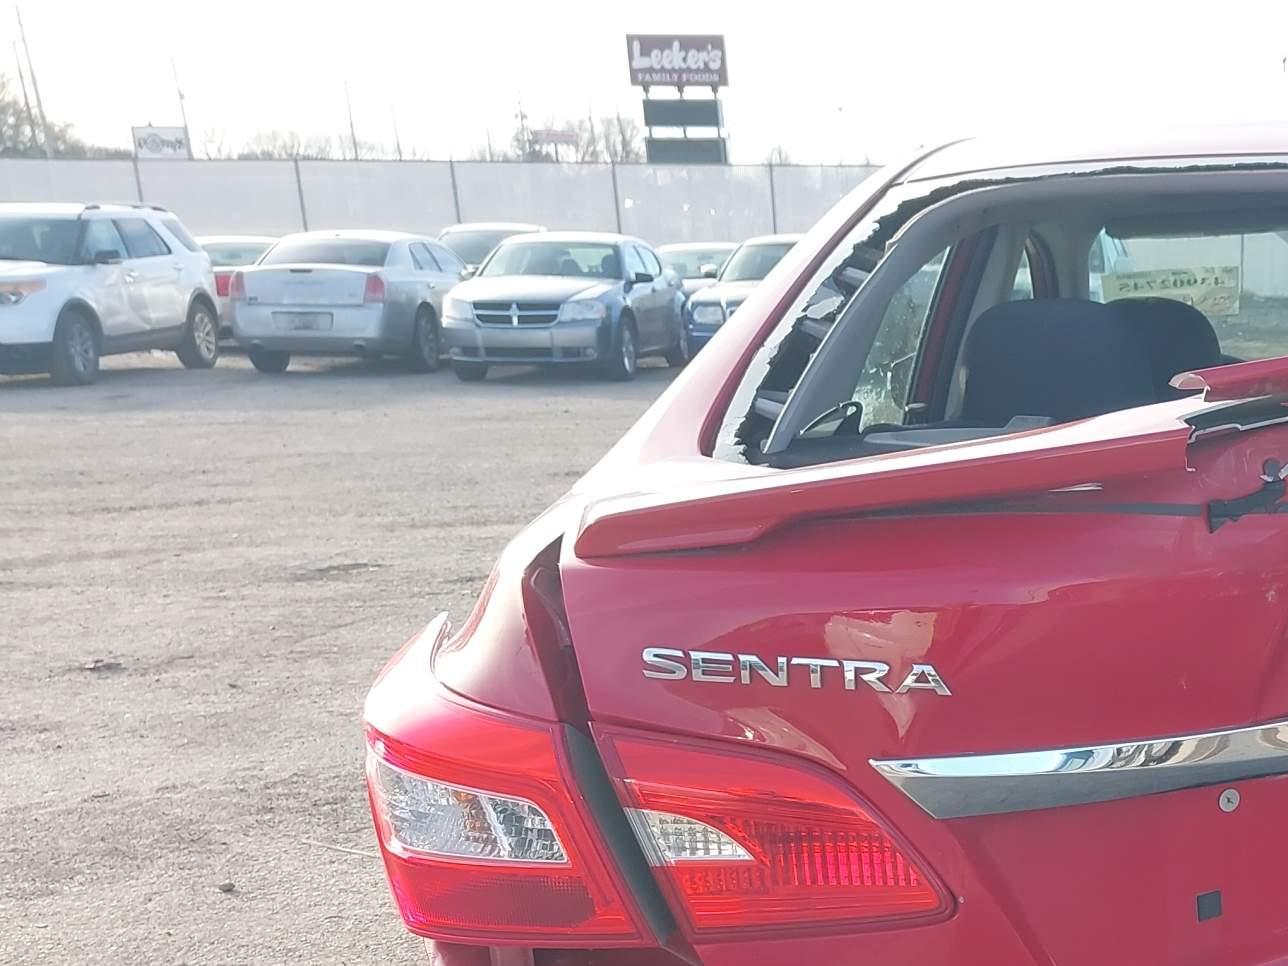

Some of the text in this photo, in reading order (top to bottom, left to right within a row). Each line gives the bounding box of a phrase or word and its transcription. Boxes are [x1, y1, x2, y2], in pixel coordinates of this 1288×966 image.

[631, 39, 722, 70] Leeker's
[637, 72, 720, 82] FAMILY FOODS
[641, 646, 953, 697] SENTRA
